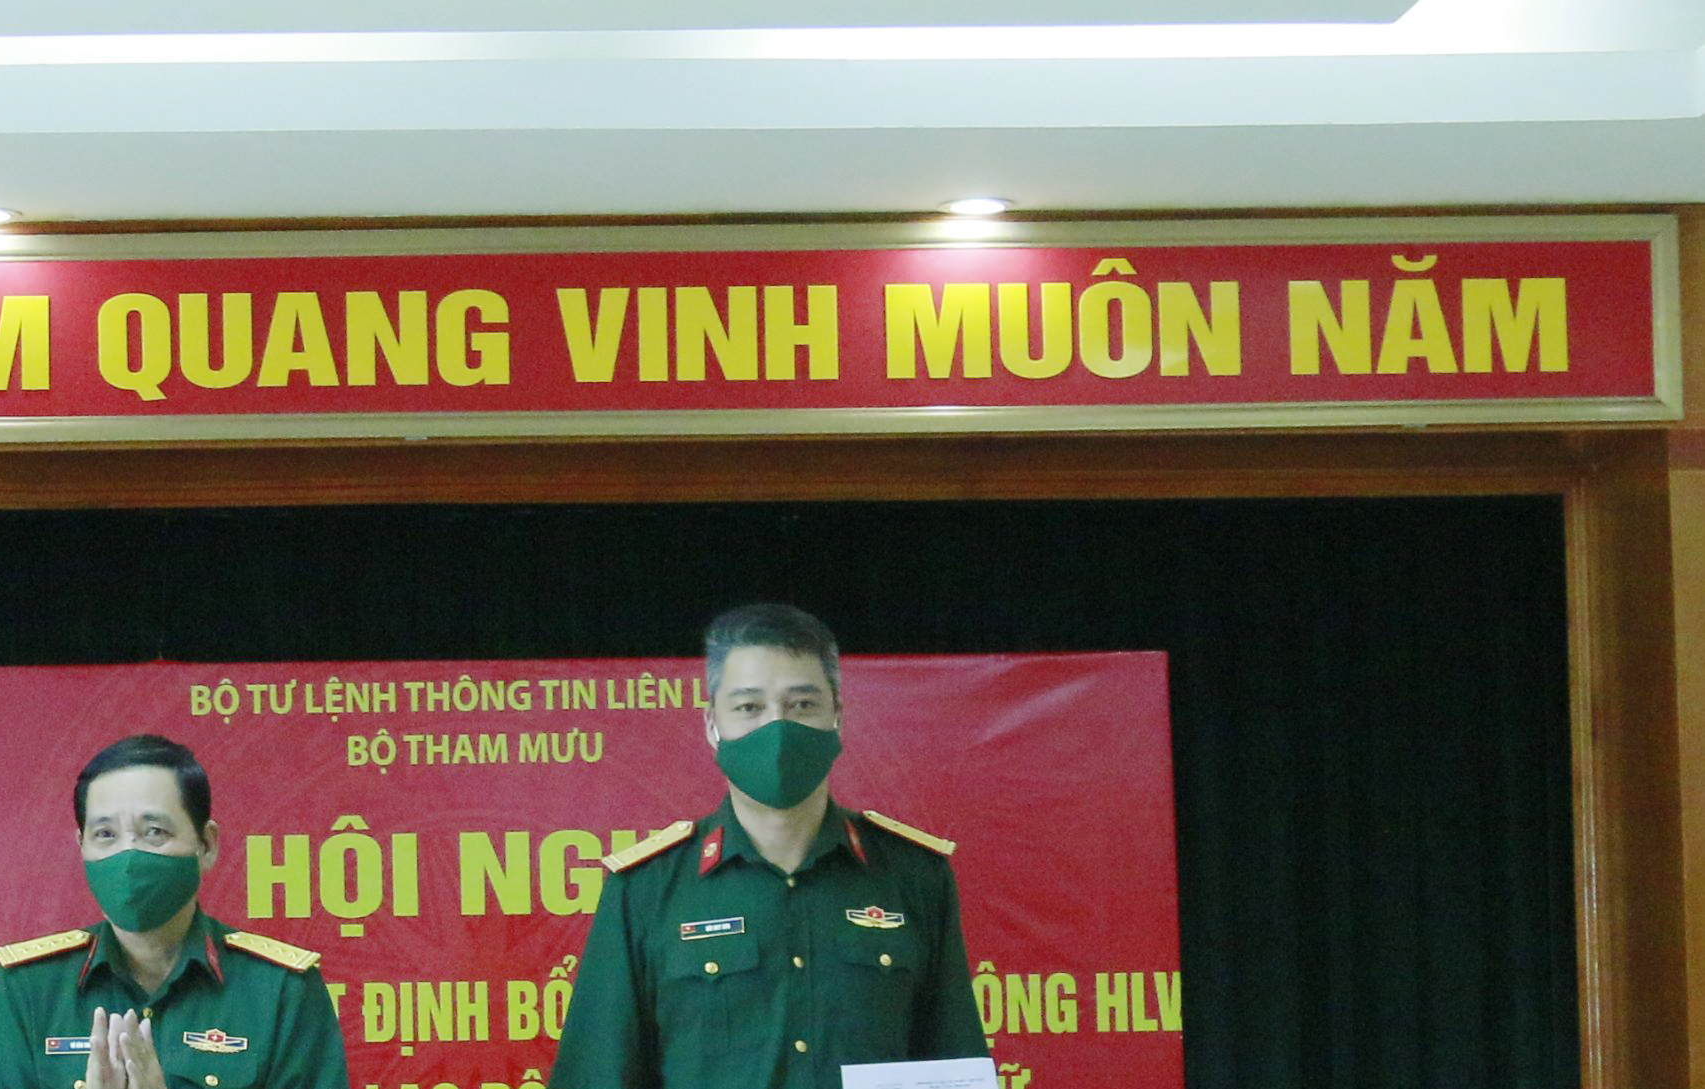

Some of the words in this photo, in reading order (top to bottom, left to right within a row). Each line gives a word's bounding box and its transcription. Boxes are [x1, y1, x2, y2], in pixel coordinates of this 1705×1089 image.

[96, 288, 511, 402] QUANG
[556, 284, 840, 383] VINH
[884, 257, 1242, 379] MUÔN
[1288, 254, 1569, 375] NĂM
[190, 678, 240, 724] BỘ
[246, 679, 297, 715] TƯ
[305, 676, 397, 722] LỆNH
[403, 674, 533, 713] THÔNG
[539, 679, 596, 710] TIN
[607, 672, 682, 709] LIÊN
[347, 728, 397, 774] BỘ
[403, 733, 509, 765] THAM
[518, 727, 604, 763] MƯU
[245, 814, 420, 938] HỘI
[458, 829, 664, 917] NG
[361, 980, 490, 1057] ĐỊNH
[971, 960, 1079, 1049] ỘNG
